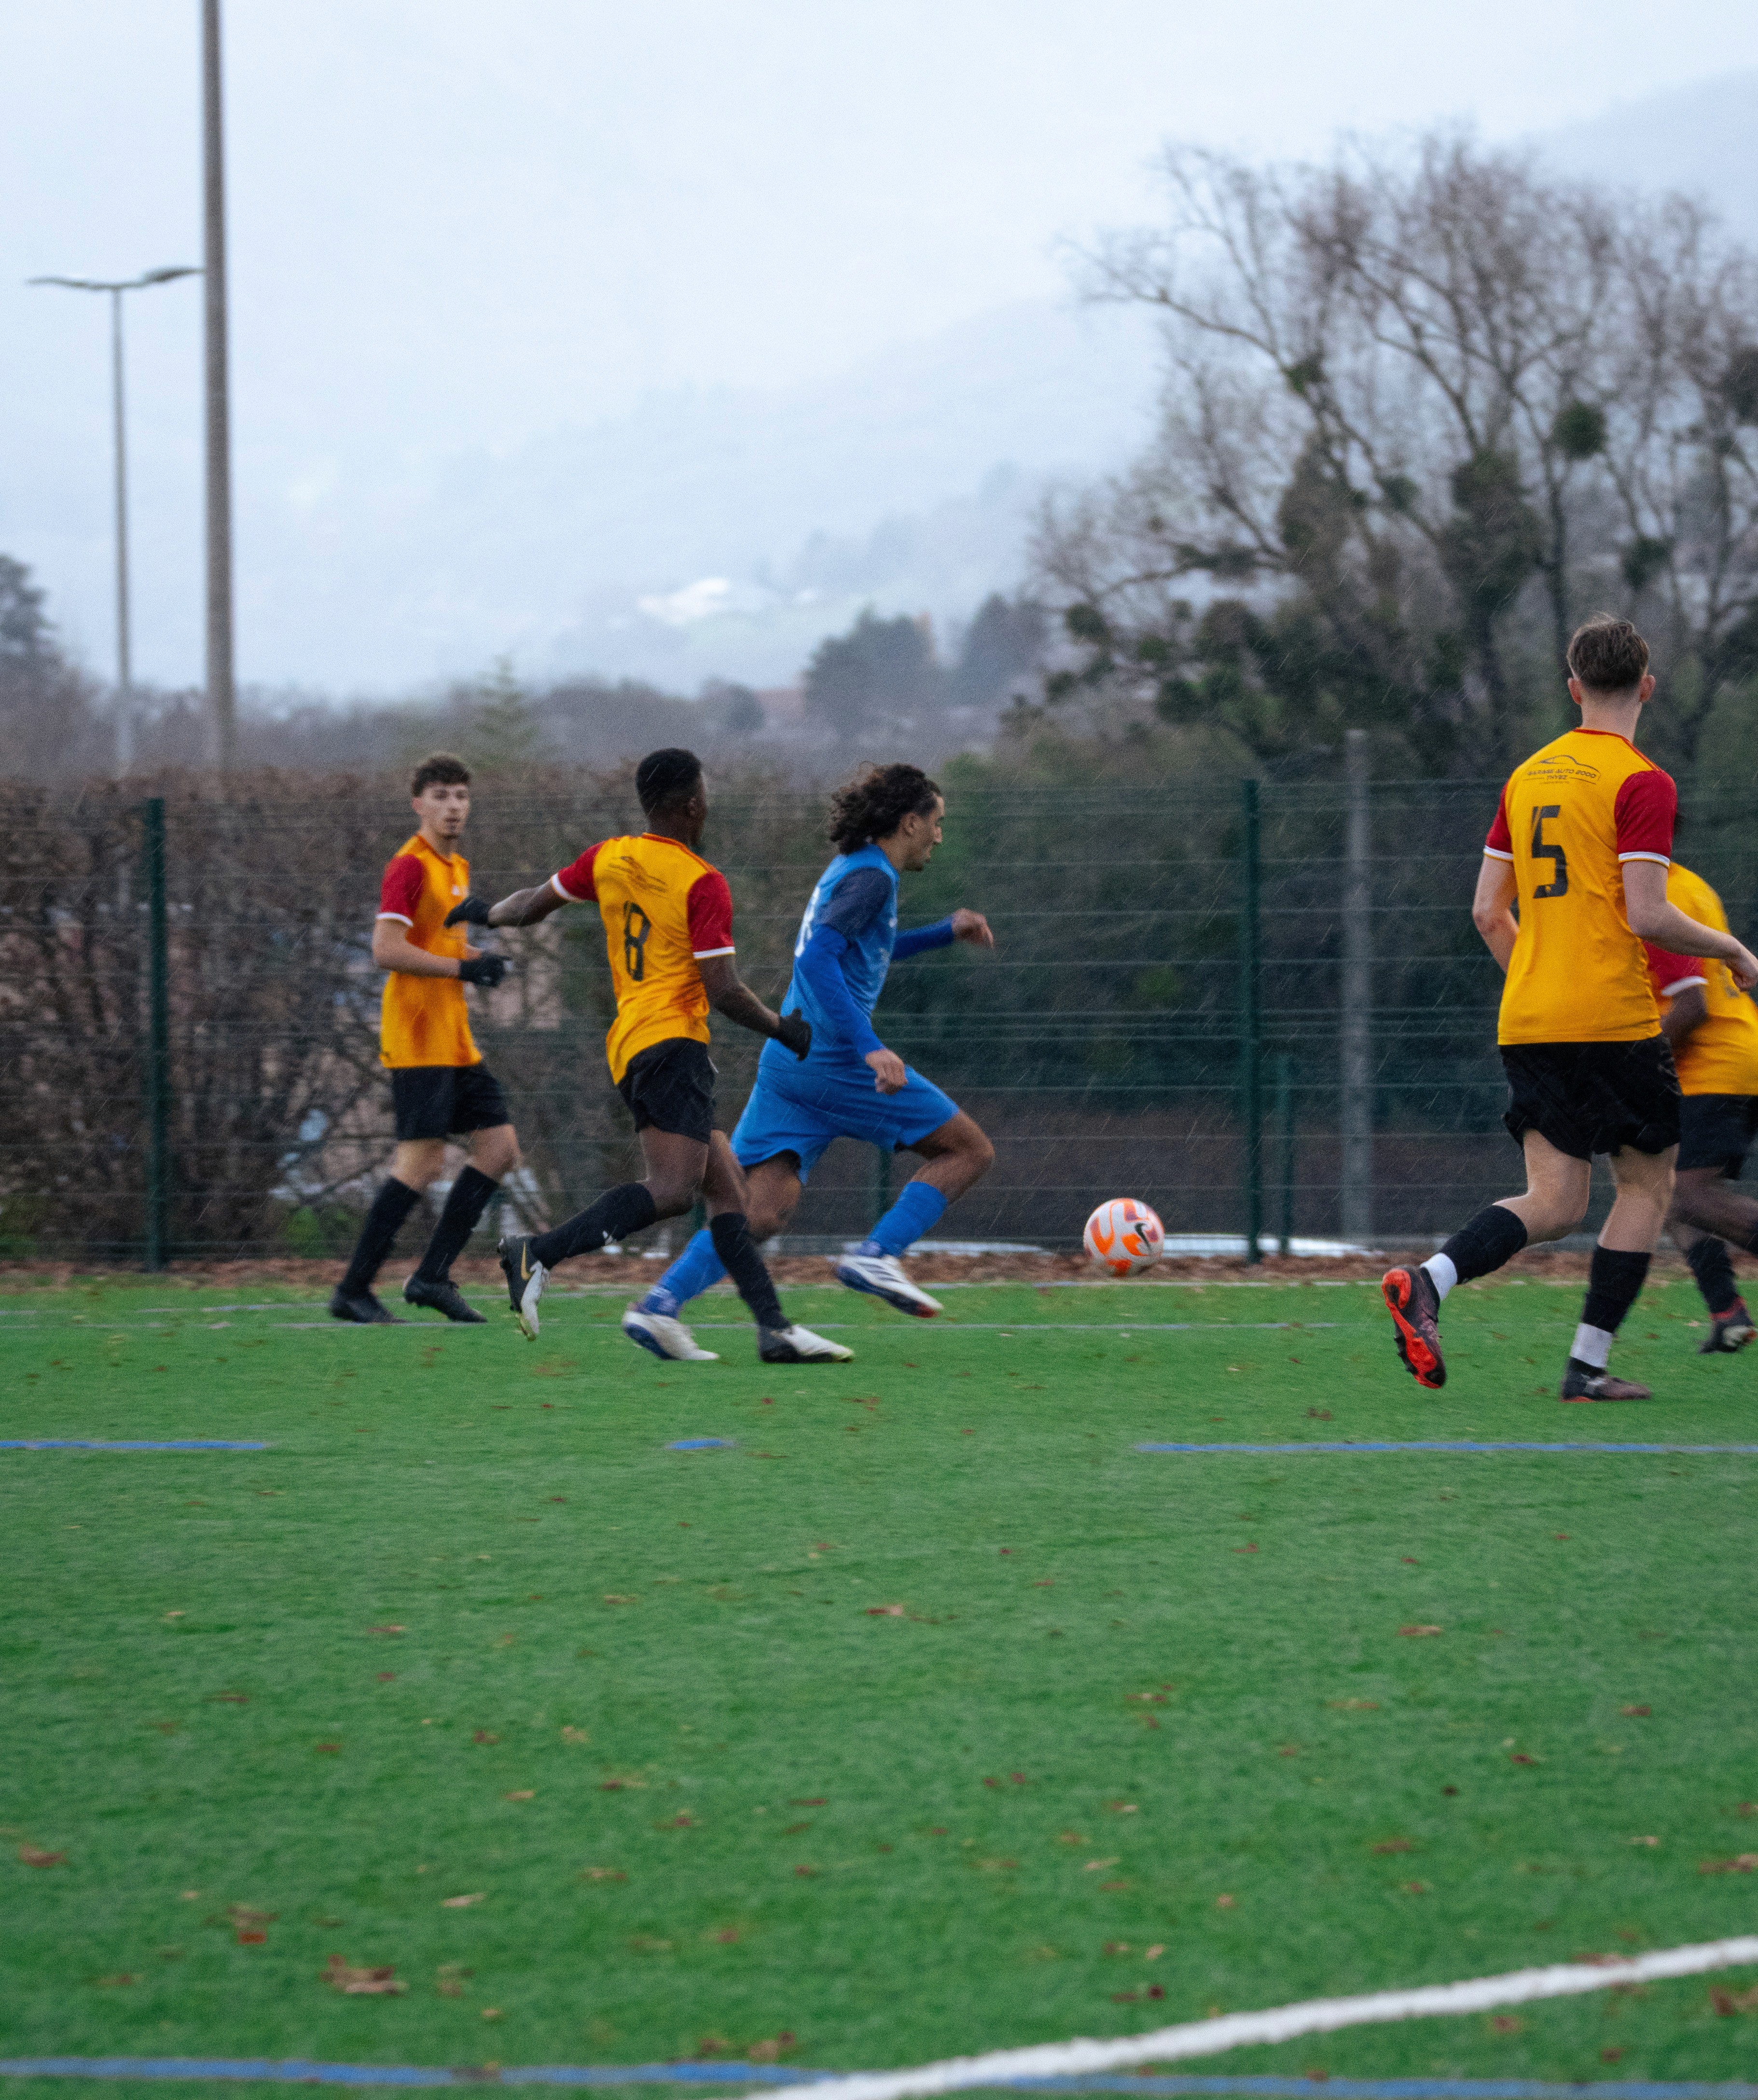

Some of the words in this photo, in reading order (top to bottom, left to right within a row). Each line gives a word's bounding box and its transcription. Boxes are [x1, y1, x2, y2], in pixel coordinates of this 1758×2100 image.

[1576, 770, 1596, 778] 2000
[1531, 805, 1568, 899] 5
[623, 900, 651, 981] 8
